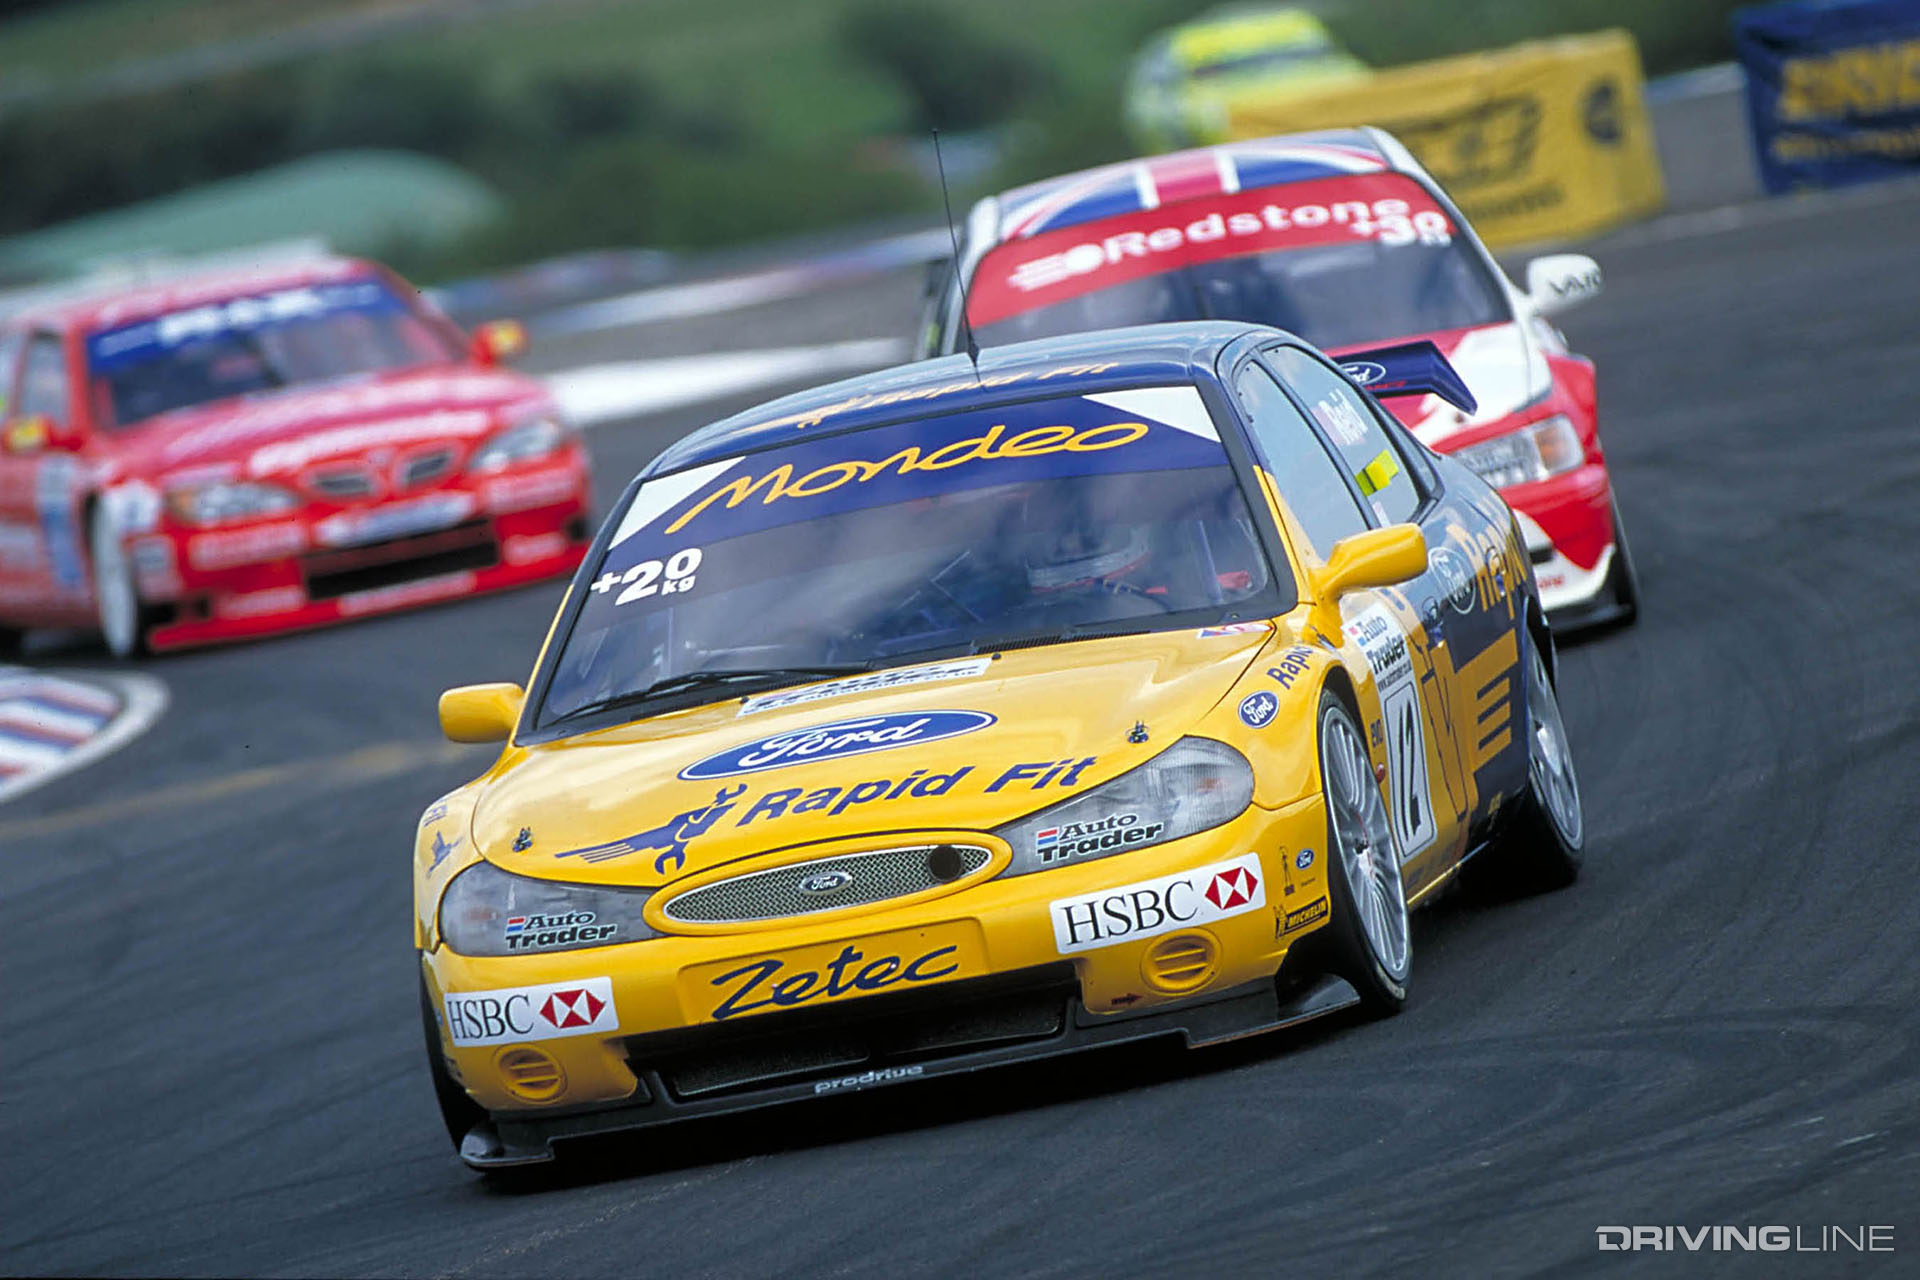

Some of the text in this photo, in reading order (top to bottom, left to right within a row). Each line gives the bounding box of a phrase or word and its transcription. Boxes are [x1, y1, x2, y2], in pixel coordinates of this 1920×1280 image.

[1105, 197, 1411, 265] Redstone
[664, 423, 1149, 535] Mondeo
[590, 547, 702, 605] +20 kg
[1243, 694, 1276, 725] Ford
[738, 719, 933, 768] Ford
[735, 756, 1099, 828] Rapid Fit
[1037, 823, 1163, 864] Trader
[1059, 813, 1138, 841] Auto
[808, 872, 845, 891] Ford
[525, 911, 595, 930] Auto
[1060, 880, 1200, 946] HSBC
[1287, 898, 1327, 928] MICHELIN
[505, 924, 617, 949] Trader
[711, 944, 960, 1022] Zetec
[447, 994, 536, 1041] HSBC
[814, 1064, 924, 1094] prodrive
